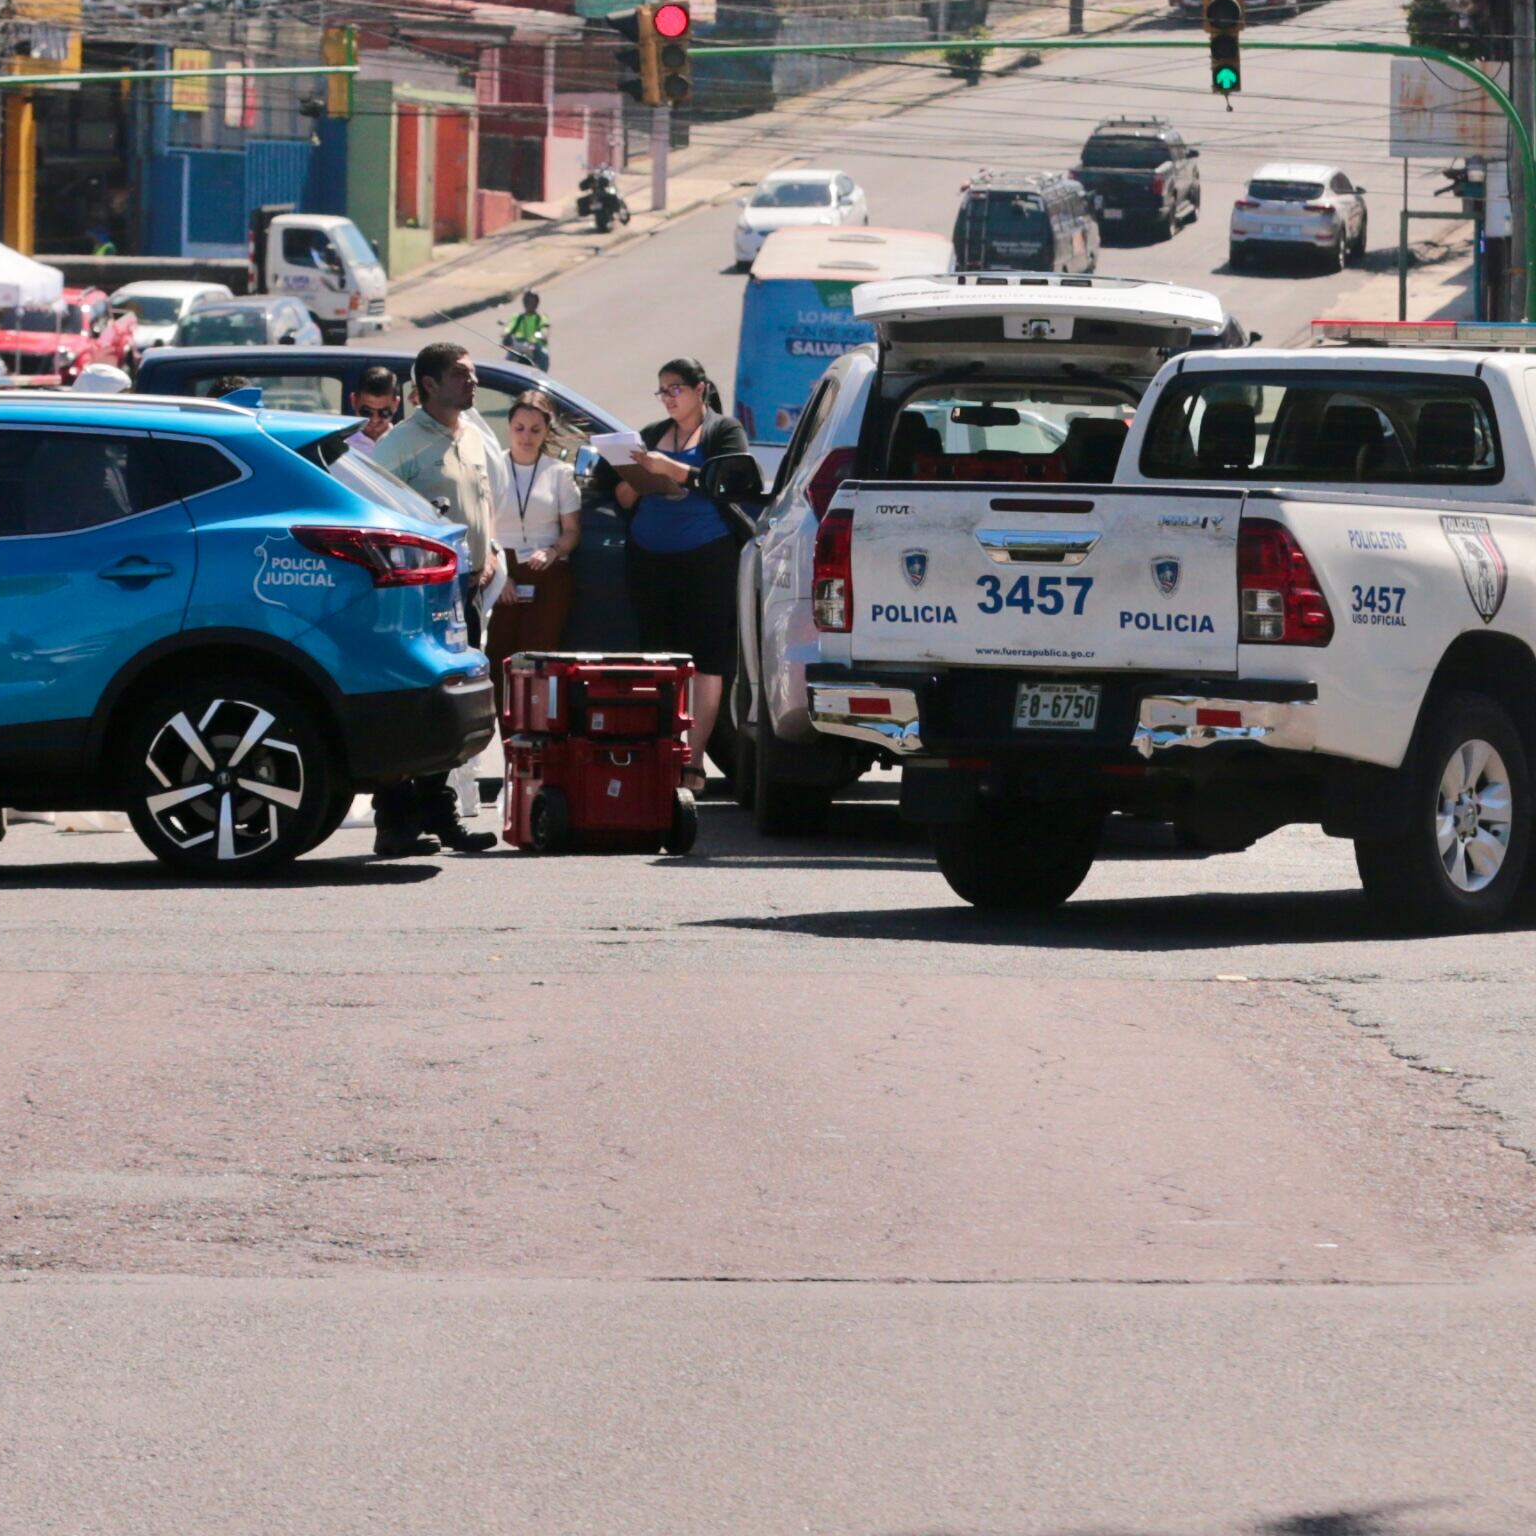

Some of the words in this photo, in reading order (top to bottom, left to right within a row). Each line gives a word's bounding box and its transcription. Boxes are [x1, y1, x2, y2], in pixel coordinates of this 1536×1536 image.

[1348, 530, 1408, 550] POLICLETOS
[271, 557, 327, 571] POLICIA
[262, 571, 337, 587] JUDICIAL
[976, 574, 1095, 616] 3457
[1351, 584, 1407, 614] 3457
[871, 604, 959, 624] POLICIA
[1119, 611, 1216, 633] POLICIA
[1352, 614, 1369, 625] USO
[1370, 615, 1407, 627] OFICIAL
[975, 647, 1096, 660] www.fuerzapublica.go.cr
[1029, 694, 1096, 719] 8-6750
